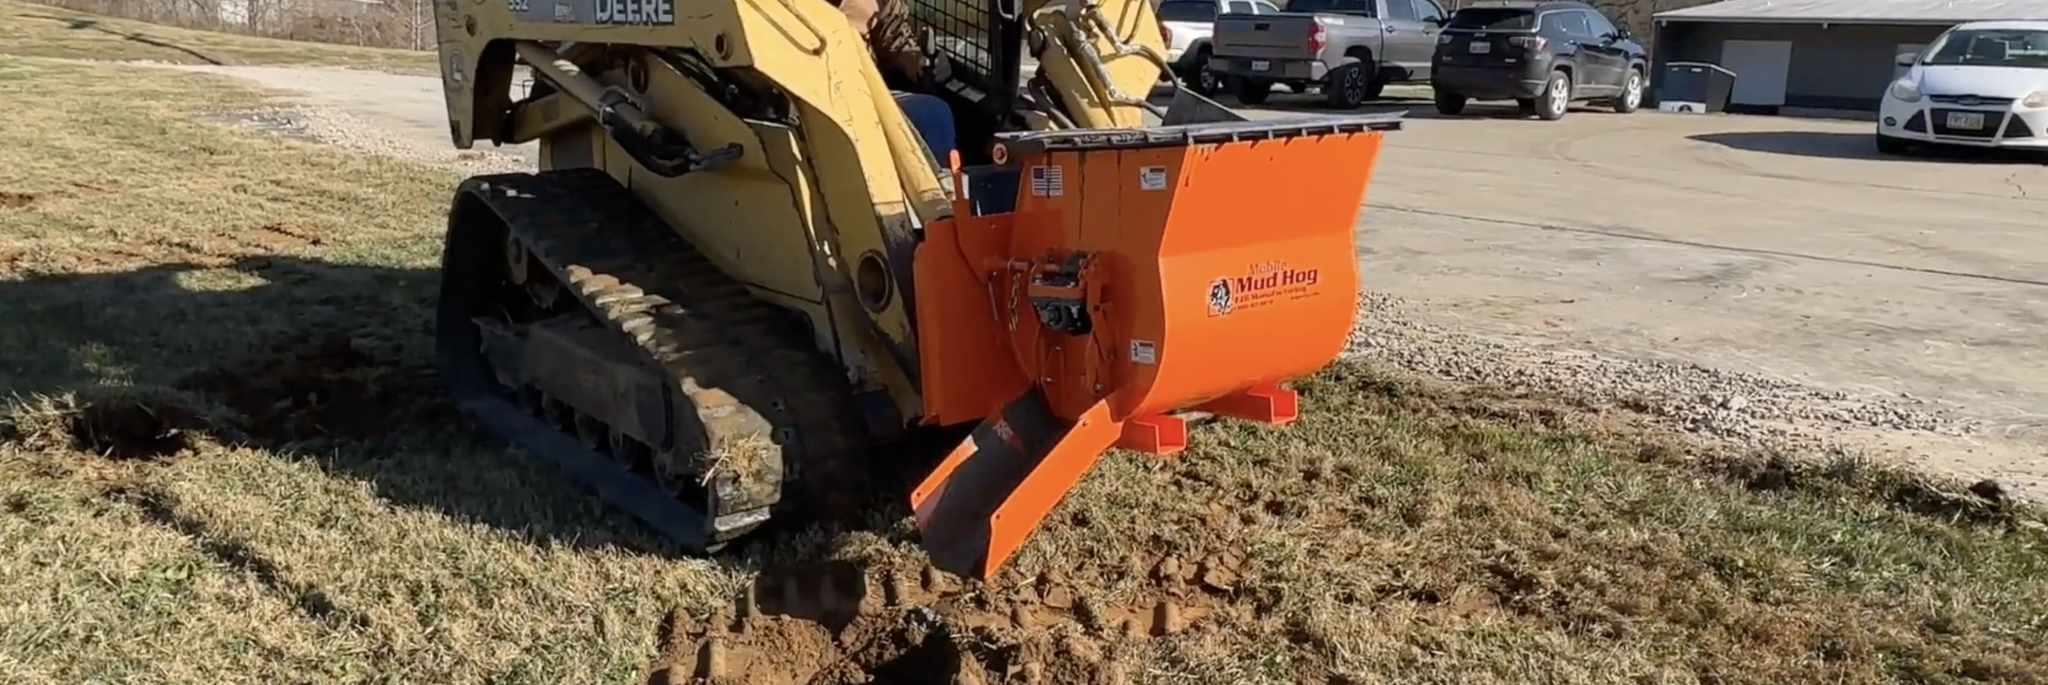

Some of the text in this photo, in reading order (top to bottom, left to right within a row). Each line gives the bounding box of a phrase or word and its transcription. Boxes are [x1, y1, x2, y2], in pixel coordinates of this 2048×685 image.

[595, 0, 674, 22] DEERE
[1248, 260, 1287, 276] Mobile
[1235, 269, 1318, 294] Mud Hog
